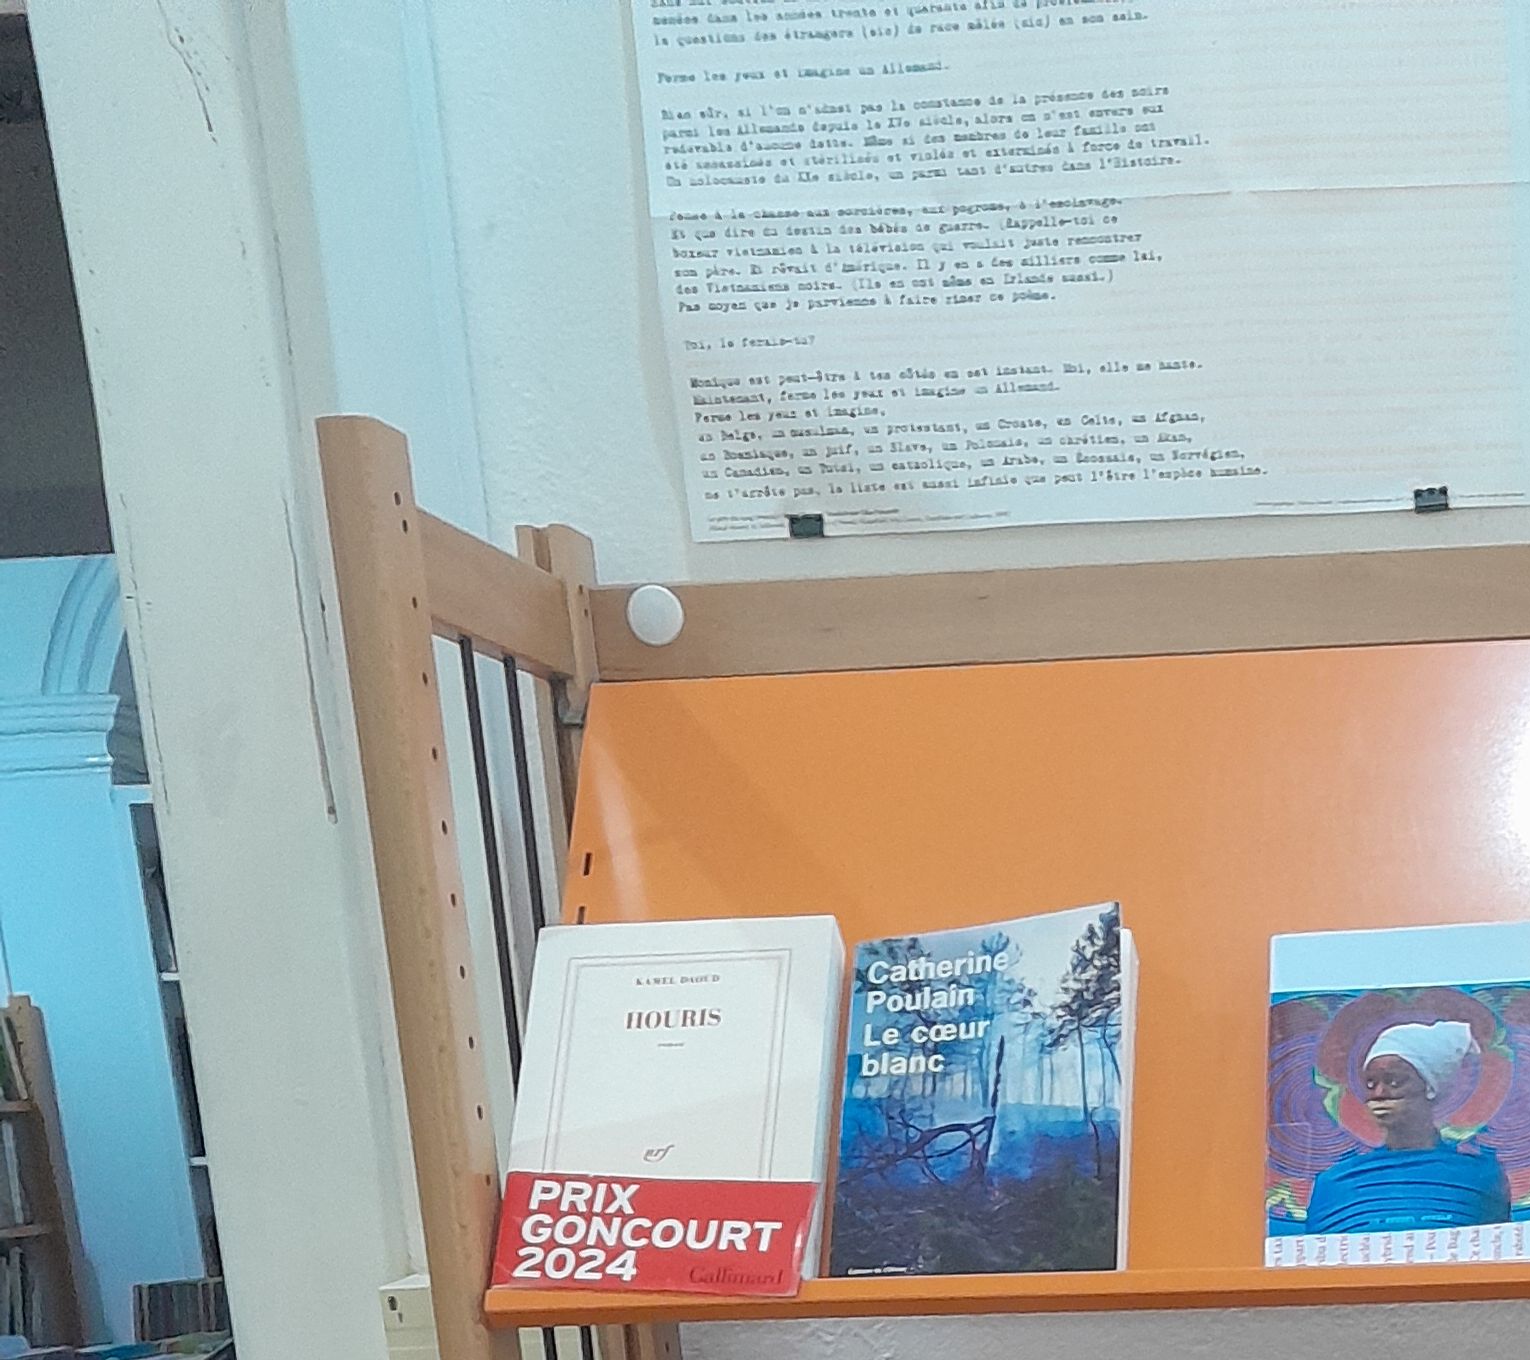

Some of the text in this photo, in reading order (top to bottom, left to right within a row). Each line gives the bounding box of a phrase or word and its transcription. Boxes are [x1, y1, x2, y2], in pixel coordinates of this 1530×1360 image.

[635, 974, 721, 986] KAMEL DAOUD
[867, 949, 1011, 986] Catherine
[865, 986, 975, 1014] Poulain
[625, 1008, 722, 1030] HOURIS
[863, 1018, 991, 1047] Le cœur
[860, 1052, 946, 1078] blanc
[529, 1180, 640, 1215] PRIX
[521, 1214, 783, 1253] GONCOURT
[513, 1247, 638, 1282] 2024
[688, 1266, 784, 1286] Gallimard
